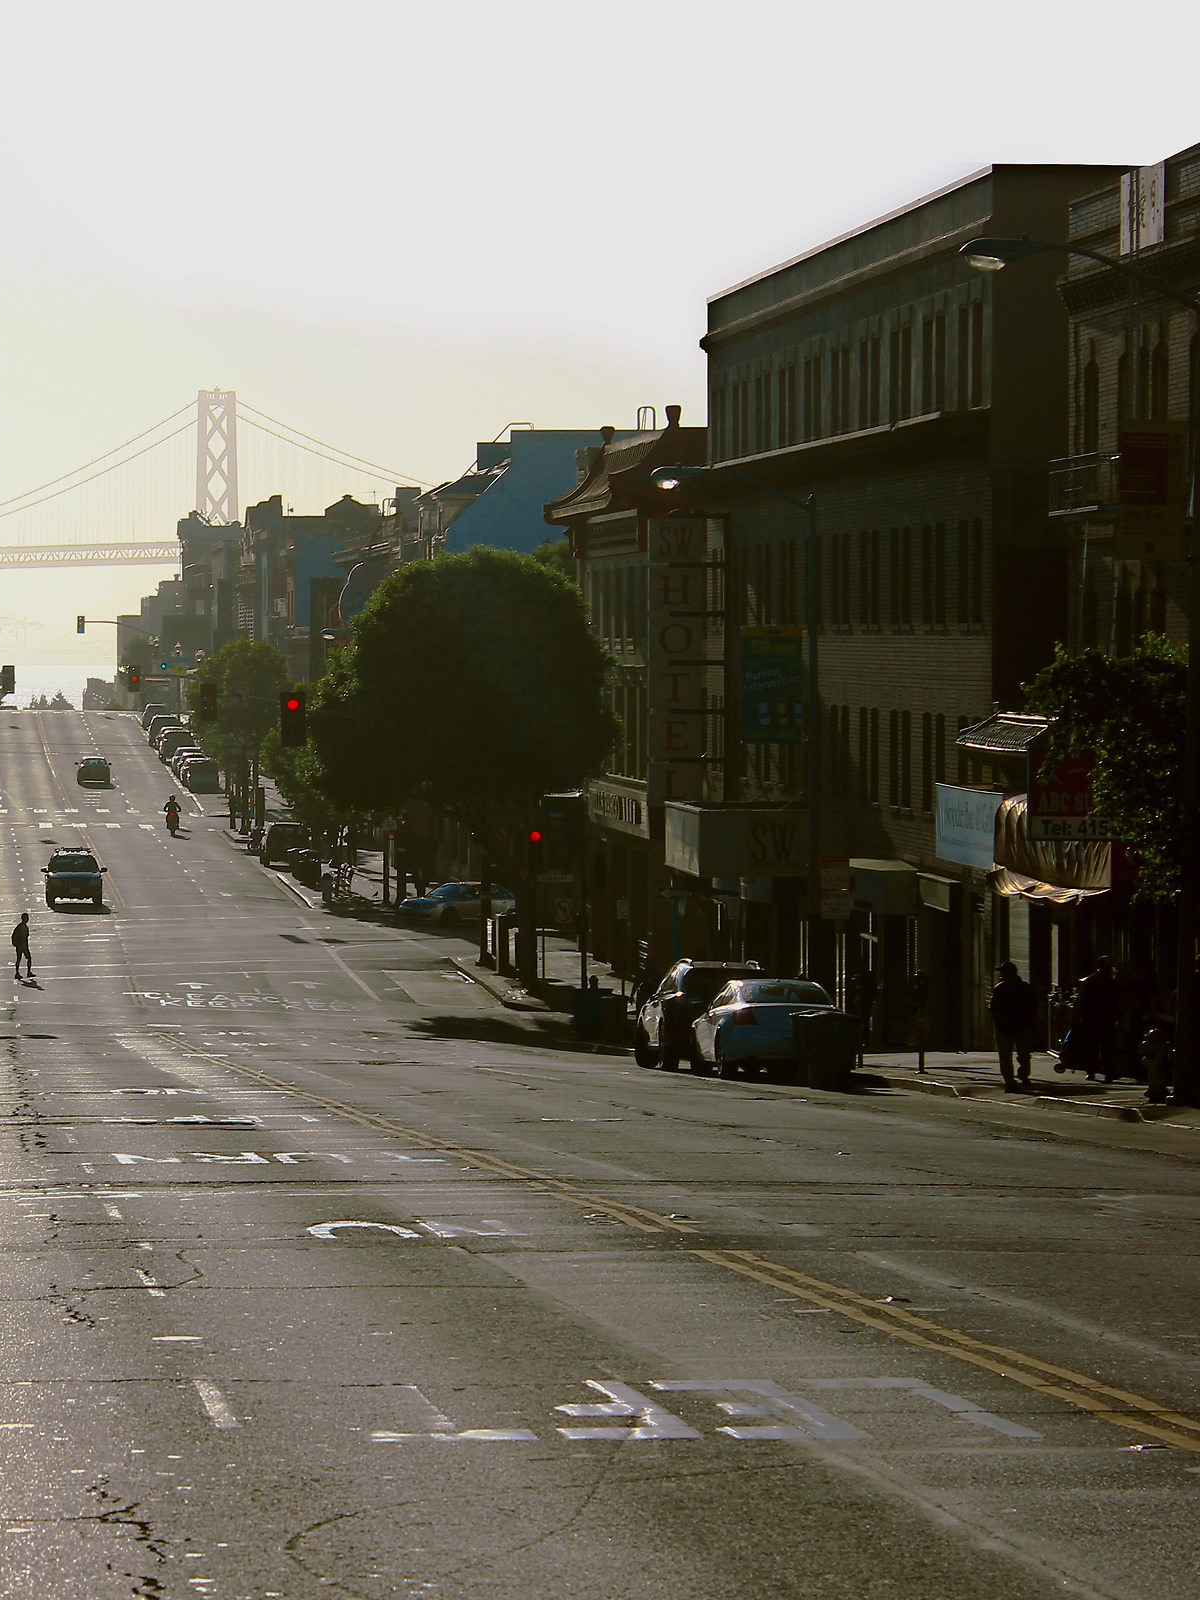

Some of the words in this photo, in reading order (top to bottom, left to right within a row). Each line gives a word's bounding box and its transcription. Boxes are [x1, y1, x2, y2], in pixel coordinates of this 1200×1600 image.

[659, 526, 693, 556] SW
[659, 574, 693, 800] HOTEL
[1041, 819, 1072, 837] Tel:
[751, 823, 796, 864] SW
[143, 992, 263, 1003] CLEAR
[159, 999, 254, 1009] KEEP
[370, 1377, 1045, 1442] LEFT
